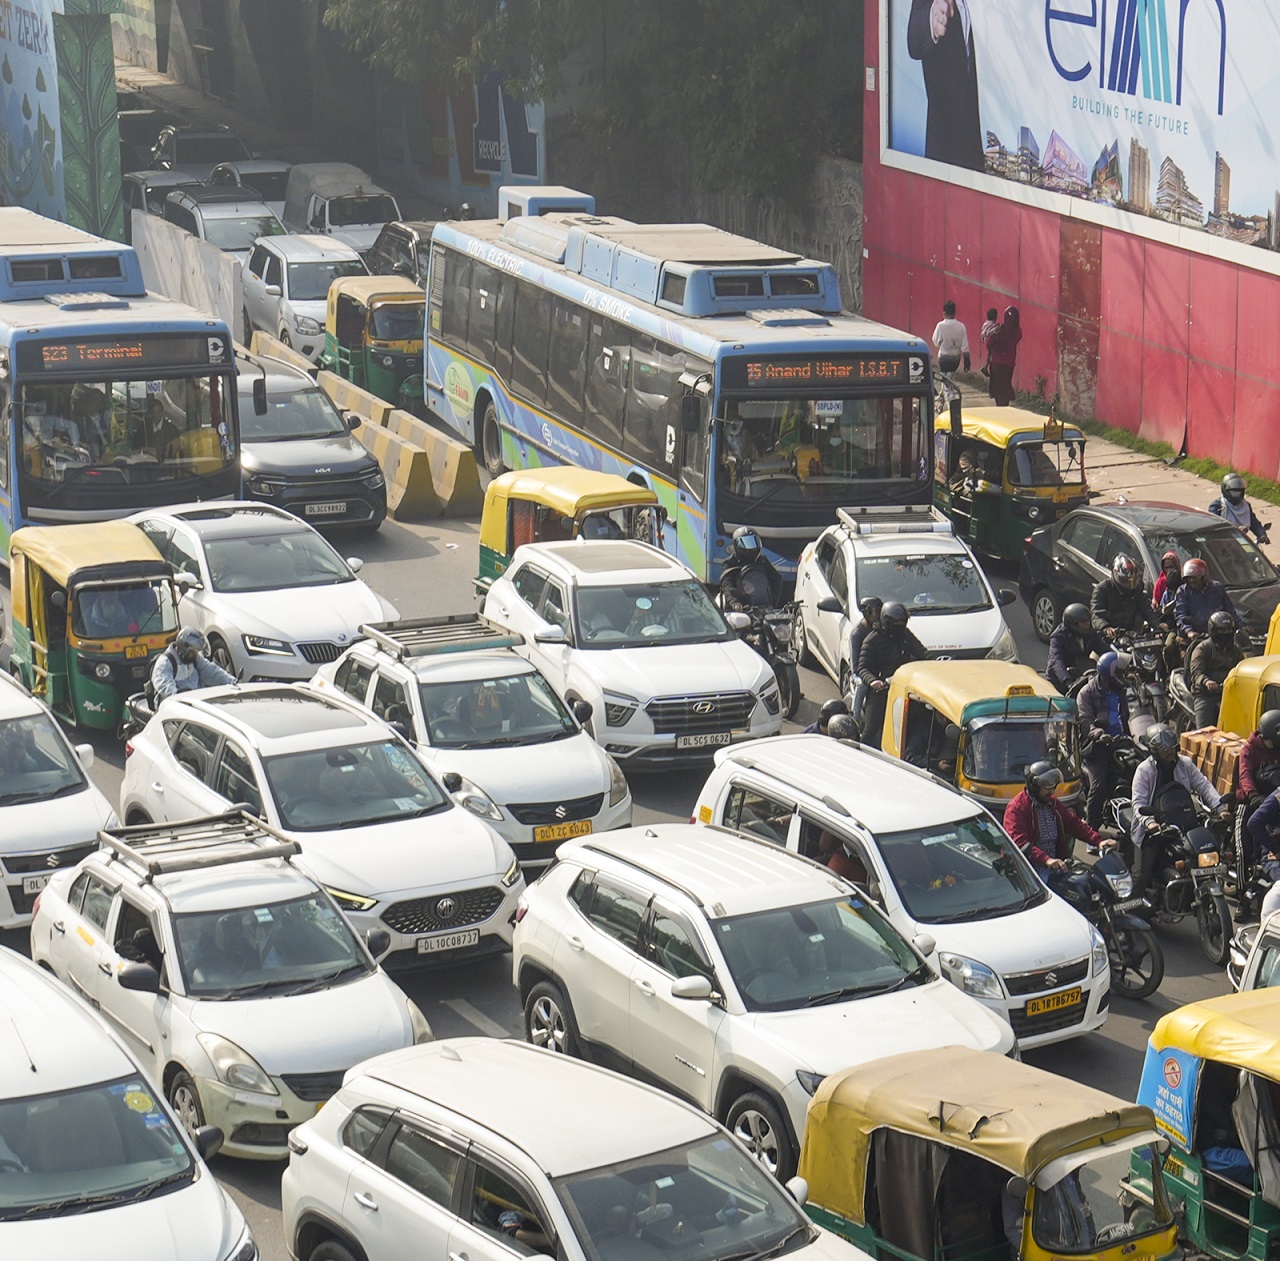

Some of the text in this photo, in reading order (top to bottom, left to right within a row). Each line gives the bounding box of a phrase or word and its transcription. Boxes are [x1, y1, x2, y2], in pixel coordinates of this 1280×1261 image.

[1072, 95, 1189, 136] BUILDING THE FUTURE
[466, 239, 487, 260] 100%
[582, 290, 599, 307] 0%
[76, 342, 143, 361] Terminal
[765, 362, 811, 379] Anand
[815, 362, 853, 378] Vihar
[710, 734, 729, 745] 0632
[1031, 992, 1081, 1013] DL1RTB6757
